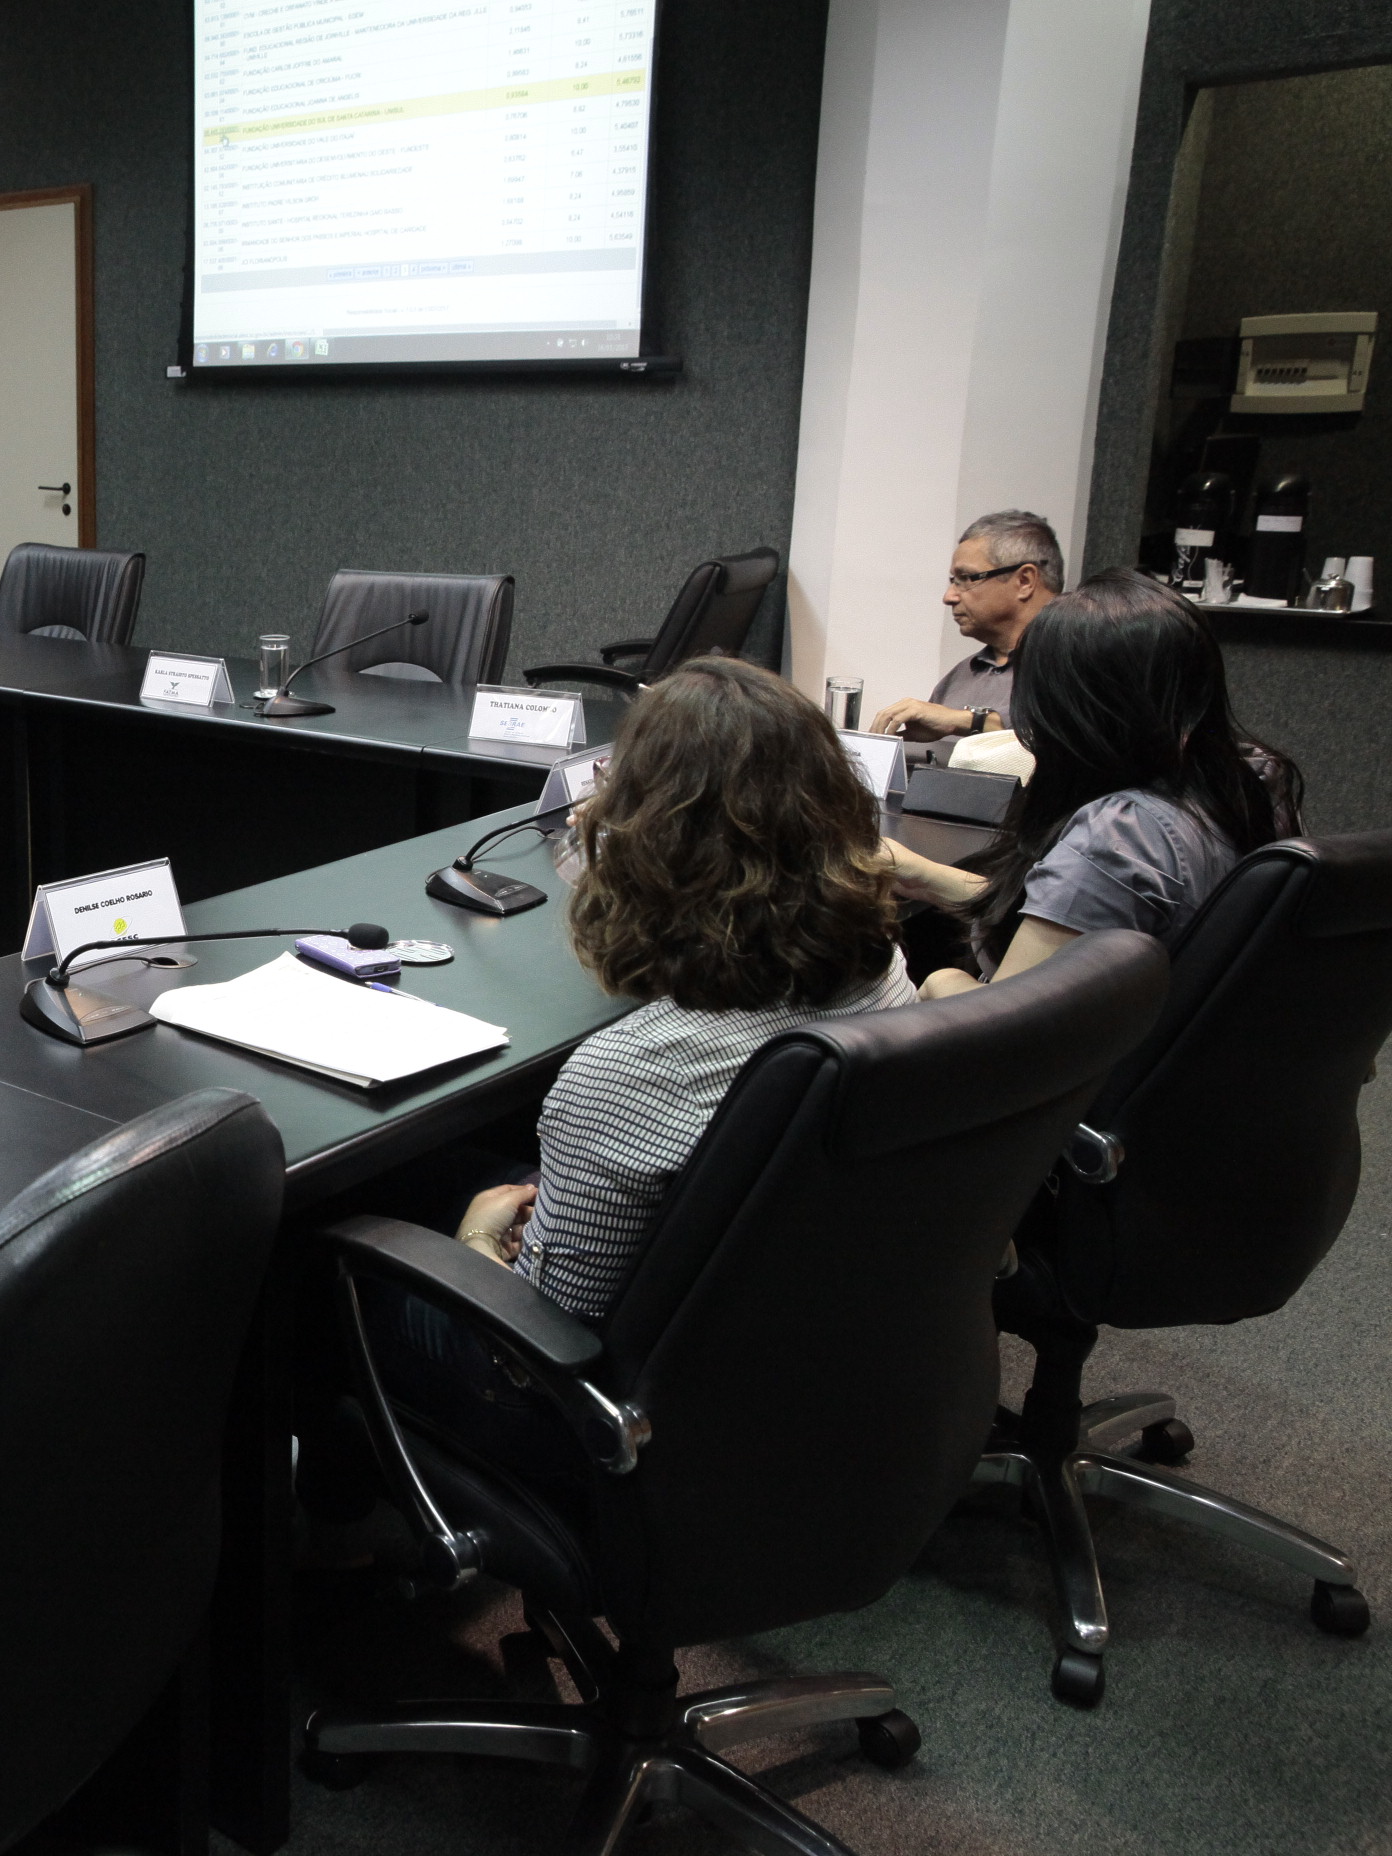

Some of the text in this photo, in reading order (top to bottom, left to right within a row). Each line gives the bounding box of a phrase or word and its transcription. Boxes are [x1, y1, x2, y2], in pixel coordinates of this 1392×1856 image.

[490, 701, 557, 713] THATIANA COLOMO
[100, 896, 125, 908] COELHO
[126, 889, 153, 902] ROSARIO
